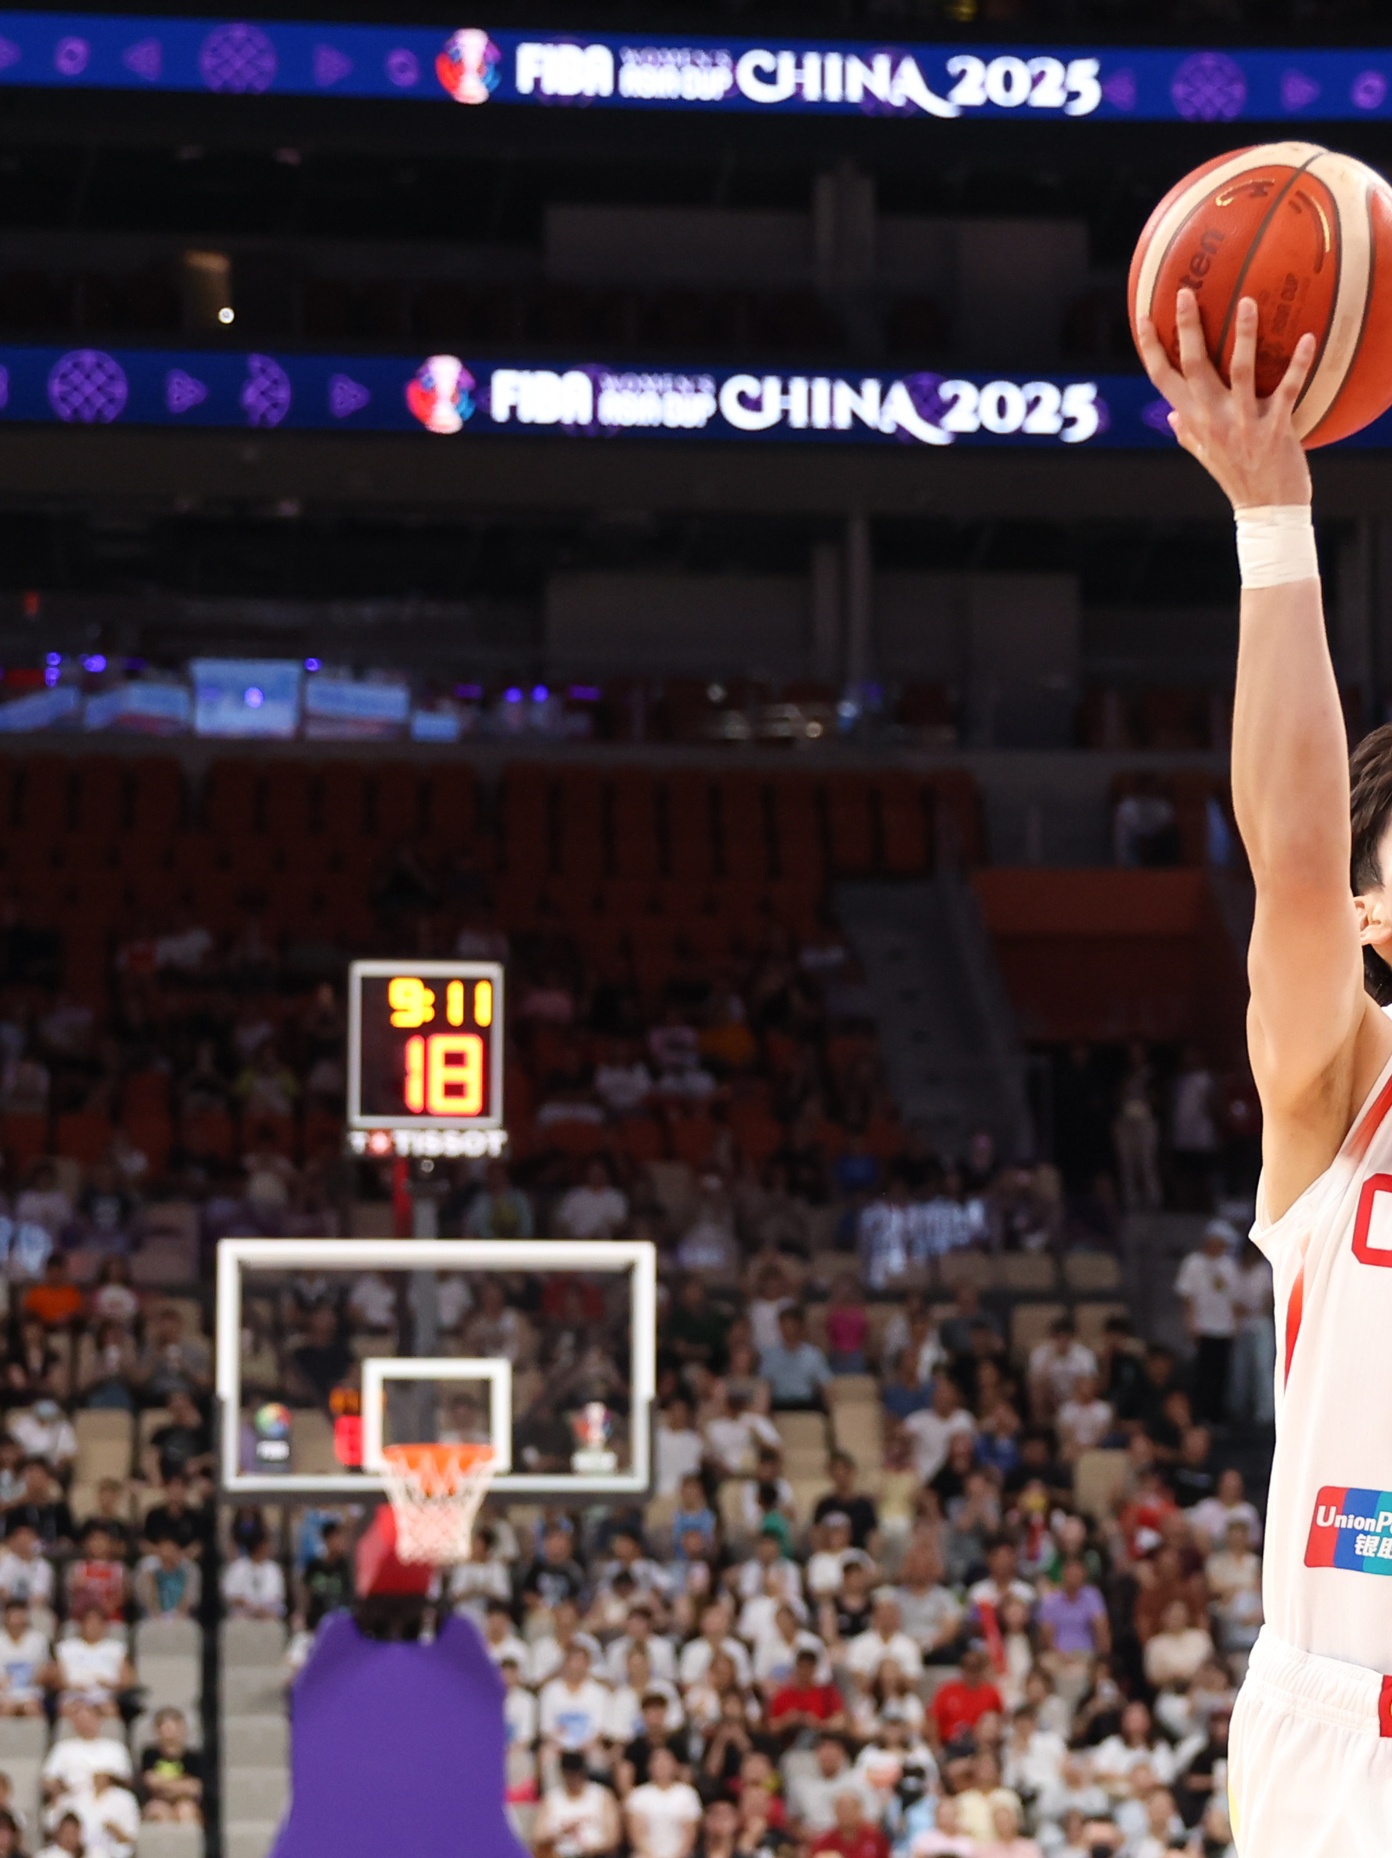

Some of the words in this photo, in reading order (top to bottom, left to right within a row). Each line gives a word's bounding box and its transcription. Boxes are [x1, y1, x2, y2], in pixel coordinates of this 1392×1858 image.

[516, 43, 615, 96] FIBA
[736, 49, 961, 118] CHINA
[946, 55, 1102, 117] 2025
[491, 370, 593, 425] FIBA
[719, 375, 954, 445] CHINA
[936, 380, 1099, 443] 2025
[388, 977, 492, 1028] 9:11
[405, 1032, 484, 1116] 18
